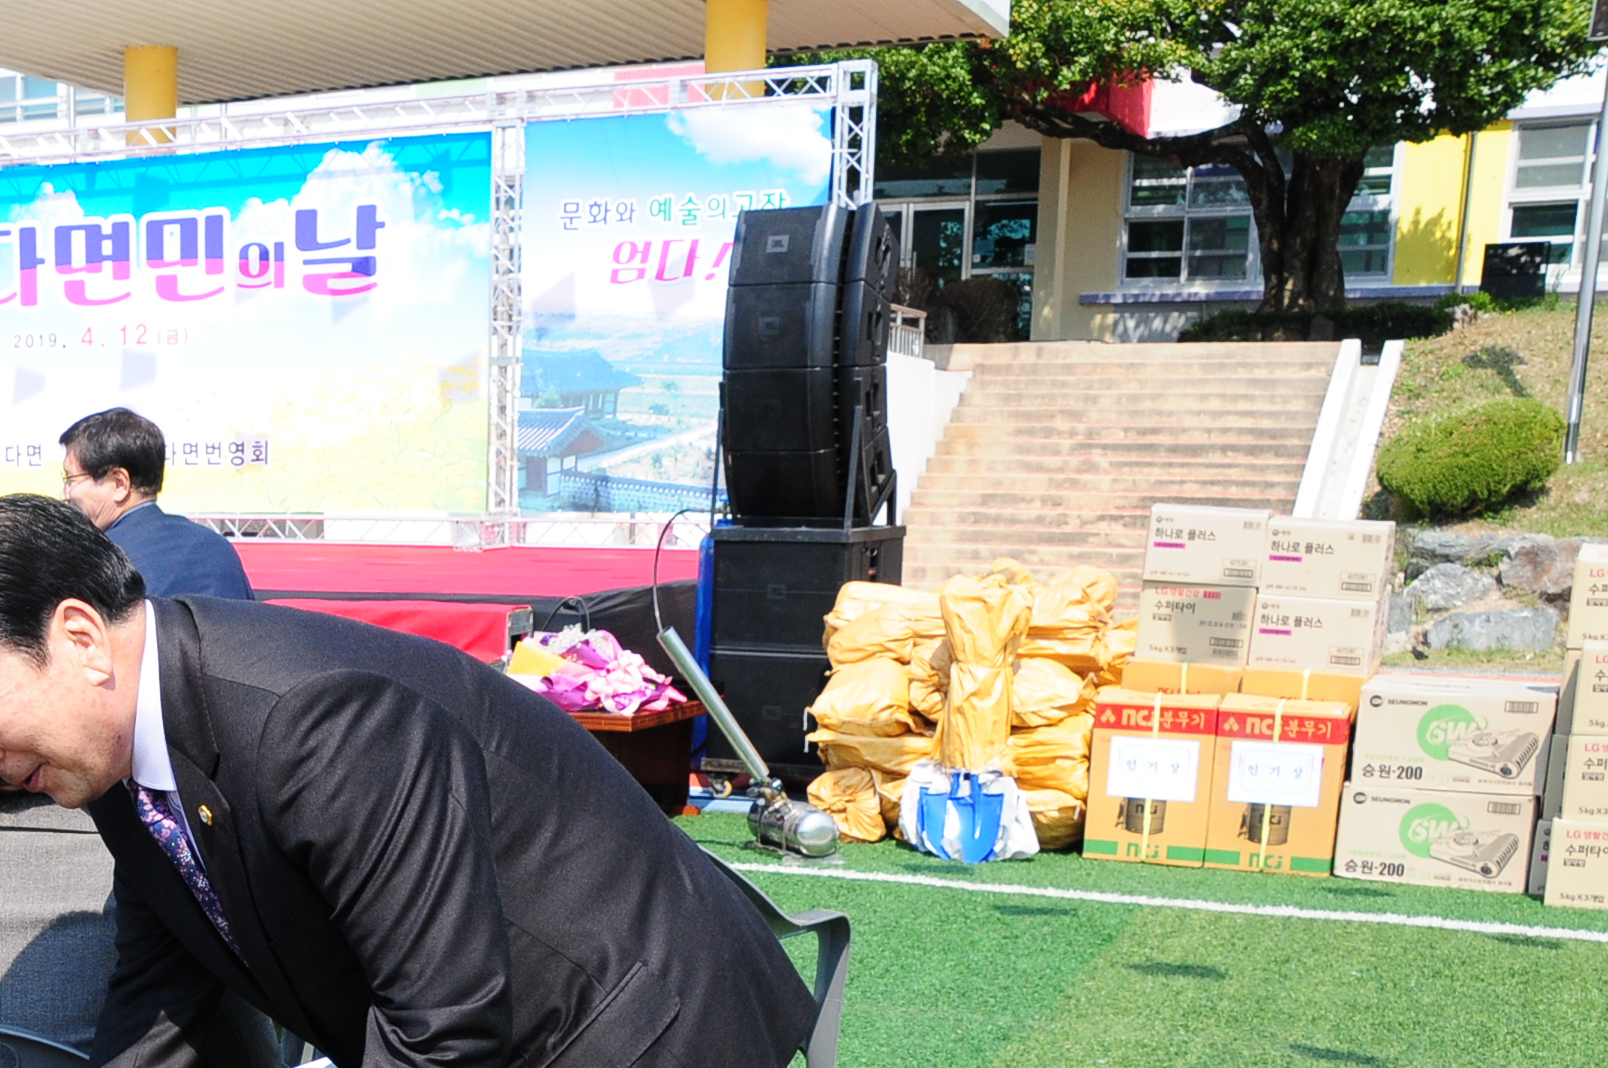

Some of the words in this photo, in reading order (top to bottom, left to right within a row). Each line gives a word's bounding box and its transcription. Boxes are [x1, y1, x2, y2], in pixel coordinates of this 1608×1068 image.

[560, 200, 636, 230] 문화와
[609, 239, 735, 285] 엄다!
[1154, 527, 1184, 541] 하나로
[1187, 528, 1217, 542] 플러스
[1271, 540, 1301, 554] 하나로
[1304, 542, 1334, 556] 플러스
[1589, 569, 1605, 578] LG
[1154, 600, 1196, 615] 수퍼타이
[1260, 613, 1290, 627] 하나로
[1293, 615, 1324, 629] 플러스
[1387, 698, 1428, 707] SEUNGWON
[1159, 710, 1206, 730] 분무기
[1284, 719, 1333, 740] 분무기
[1584, 743, 1600, 753] LG
[1361, 762, 1423, 780] 승원-200
[1370, 796, 1411, 805] SEUNGWON
[1566, 830, 1582, 839] LG
[1344, 859, 1405, 878] 승원-200
